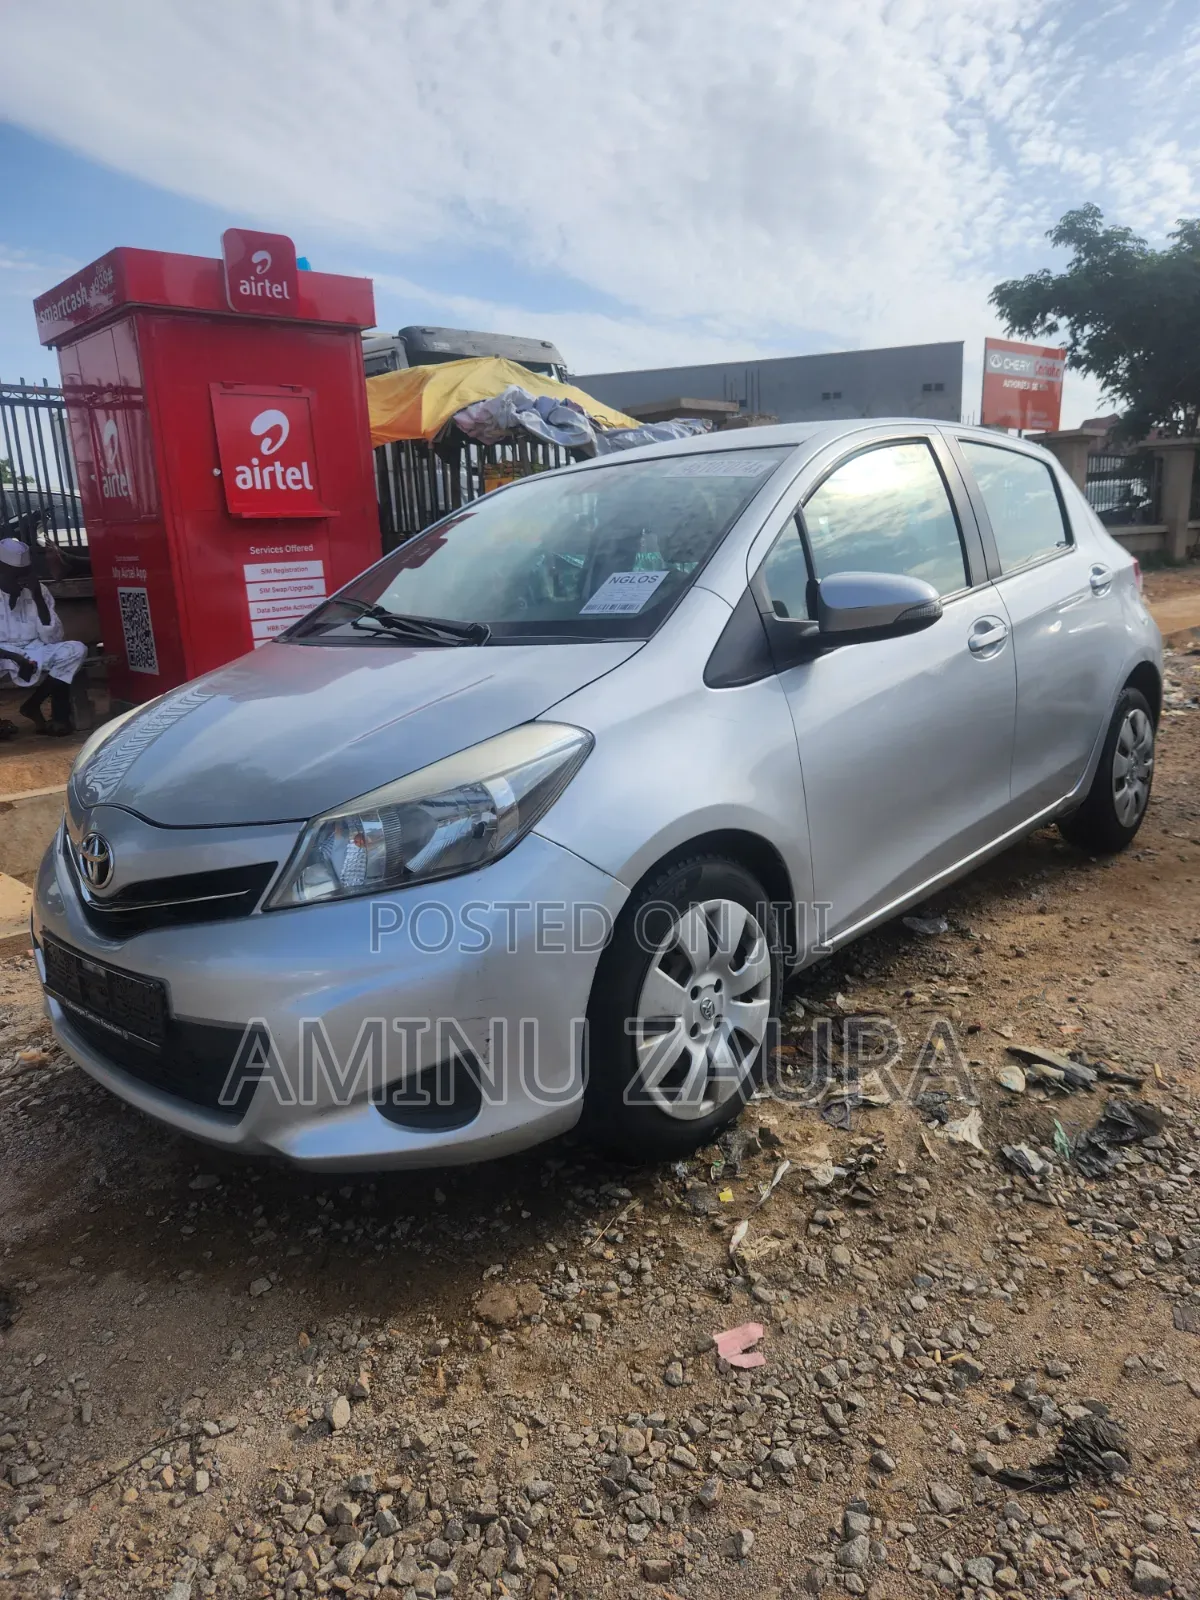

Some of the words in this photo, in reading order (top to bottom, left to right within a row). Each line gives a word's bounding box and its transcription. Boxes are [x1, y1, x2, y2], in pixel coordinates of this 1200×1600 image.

[239, 276, 290, 300] airtel
[39, 282, 88, 326] smartcash
[1004, 358, 1030, 371] CHERY
[235, 457, 314, 491] airtel
[102, 467, 133, 498] airtel
[285, 544, 313, 553] Offered
[273, 566, 309, 576] Registration
[608, 574, 659, 585] NGLOS
[271, 584, 314, 594] Swap/Upgrade
